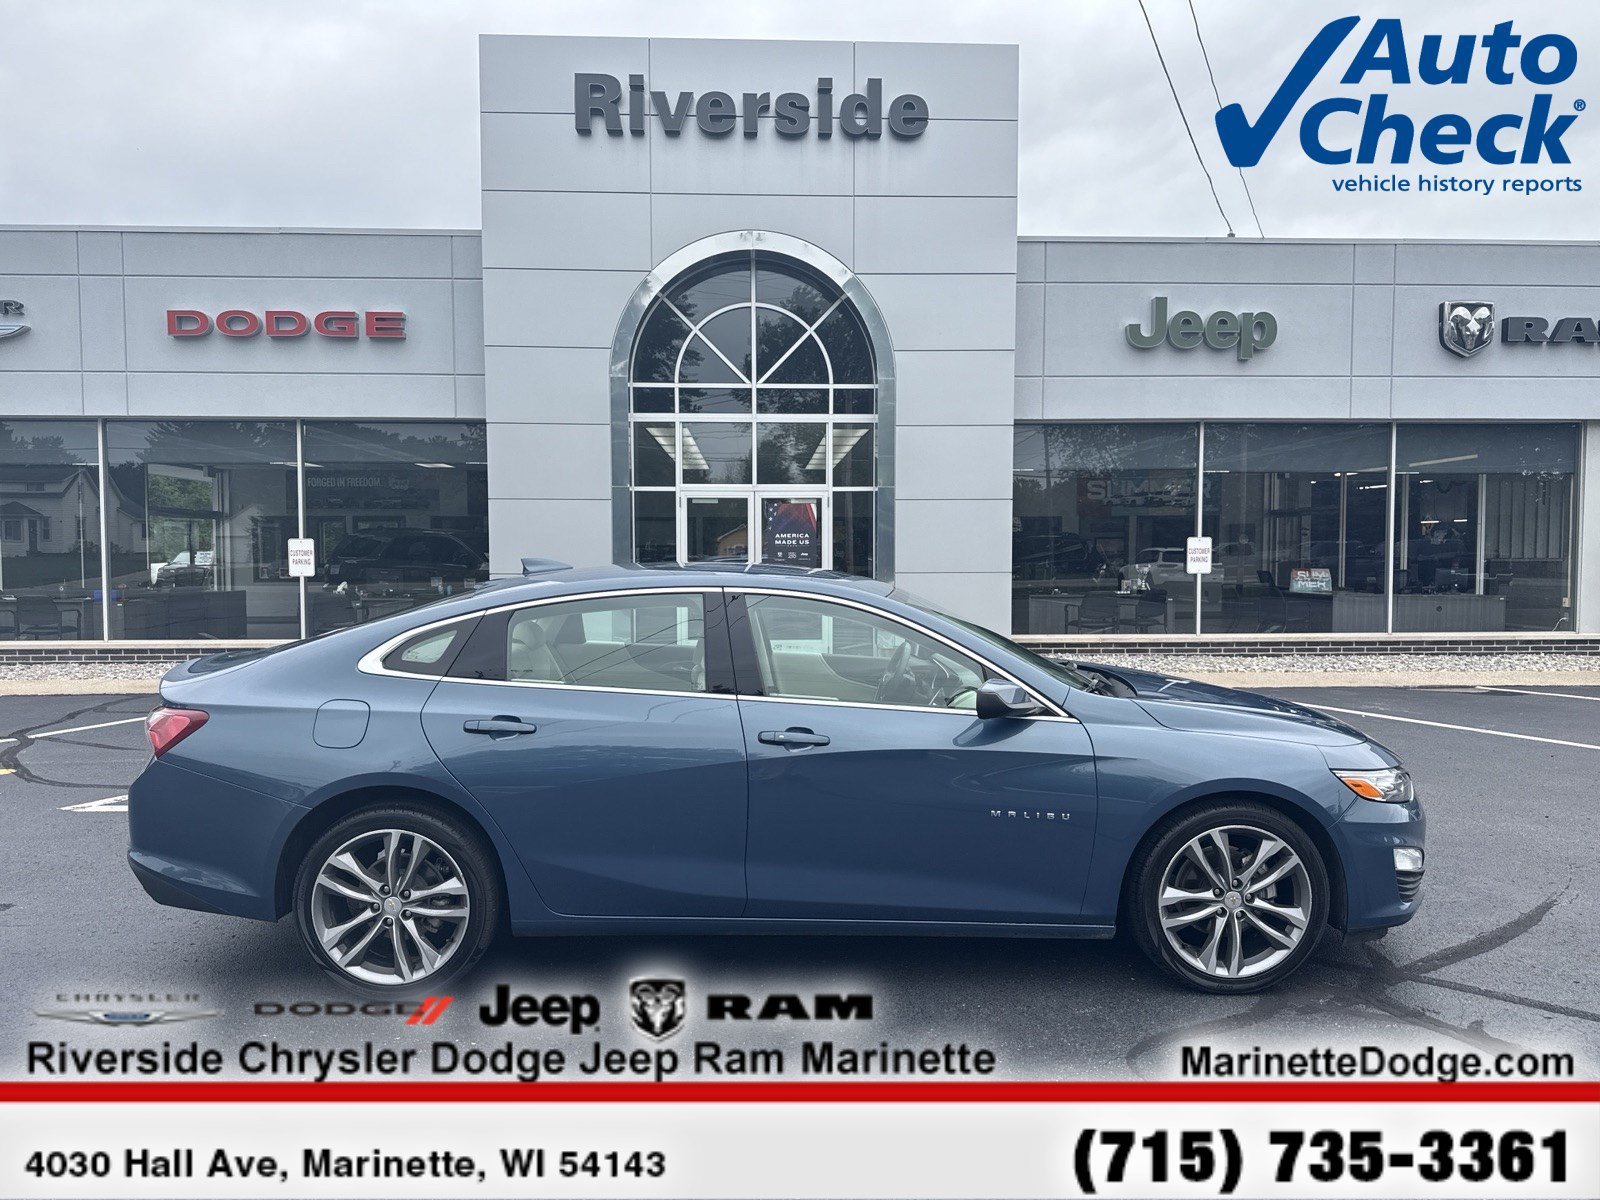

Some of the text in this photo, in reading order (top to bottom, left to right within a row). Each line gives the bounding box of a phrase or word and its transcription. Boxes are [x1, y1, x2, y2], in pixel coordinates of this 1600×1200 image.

[574, 73, 929, 140] Riverside
[167, 309, 406, 339] DODGE
[1125, 296, 1277, 361] Jeep
[1501, 316, 1600, 343] RA
[307, 477, 336, 487] FORGED
[336, 477, 345, 487] IN
[290, 549, 313, 557] CUSTOMER
[1188, 547, 1210, 555] CUSTOMER
[990, 810, 1070, 820] MALIBU
